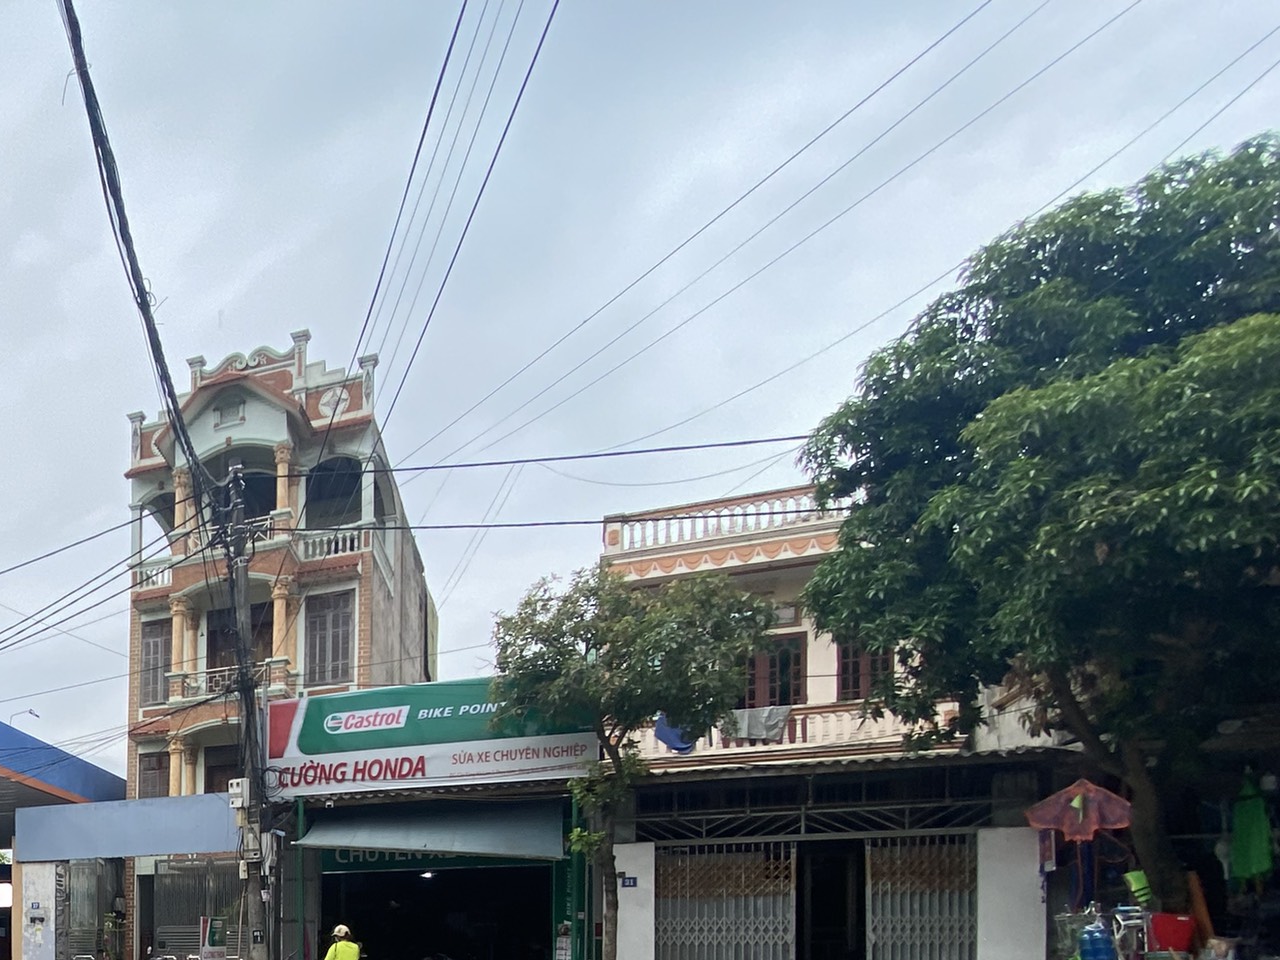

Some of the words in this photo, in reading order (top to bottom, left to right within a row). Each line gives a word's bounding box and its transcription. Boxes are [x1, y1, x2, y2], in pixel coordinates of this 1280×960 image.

[343, 709, 403, 731] Castrol
[417, 706, 454, 720] BIKE
[452, 750, 474, 765] SỬA
[477, 751, 491, 764] XE
[493, 745, 540, 762] CHUYÊN
[543, 743, 588, 760] NGHIỆP
[278, 759, 348, 788] CƯỜNG
[351, 755, 426, 782] HONDA
